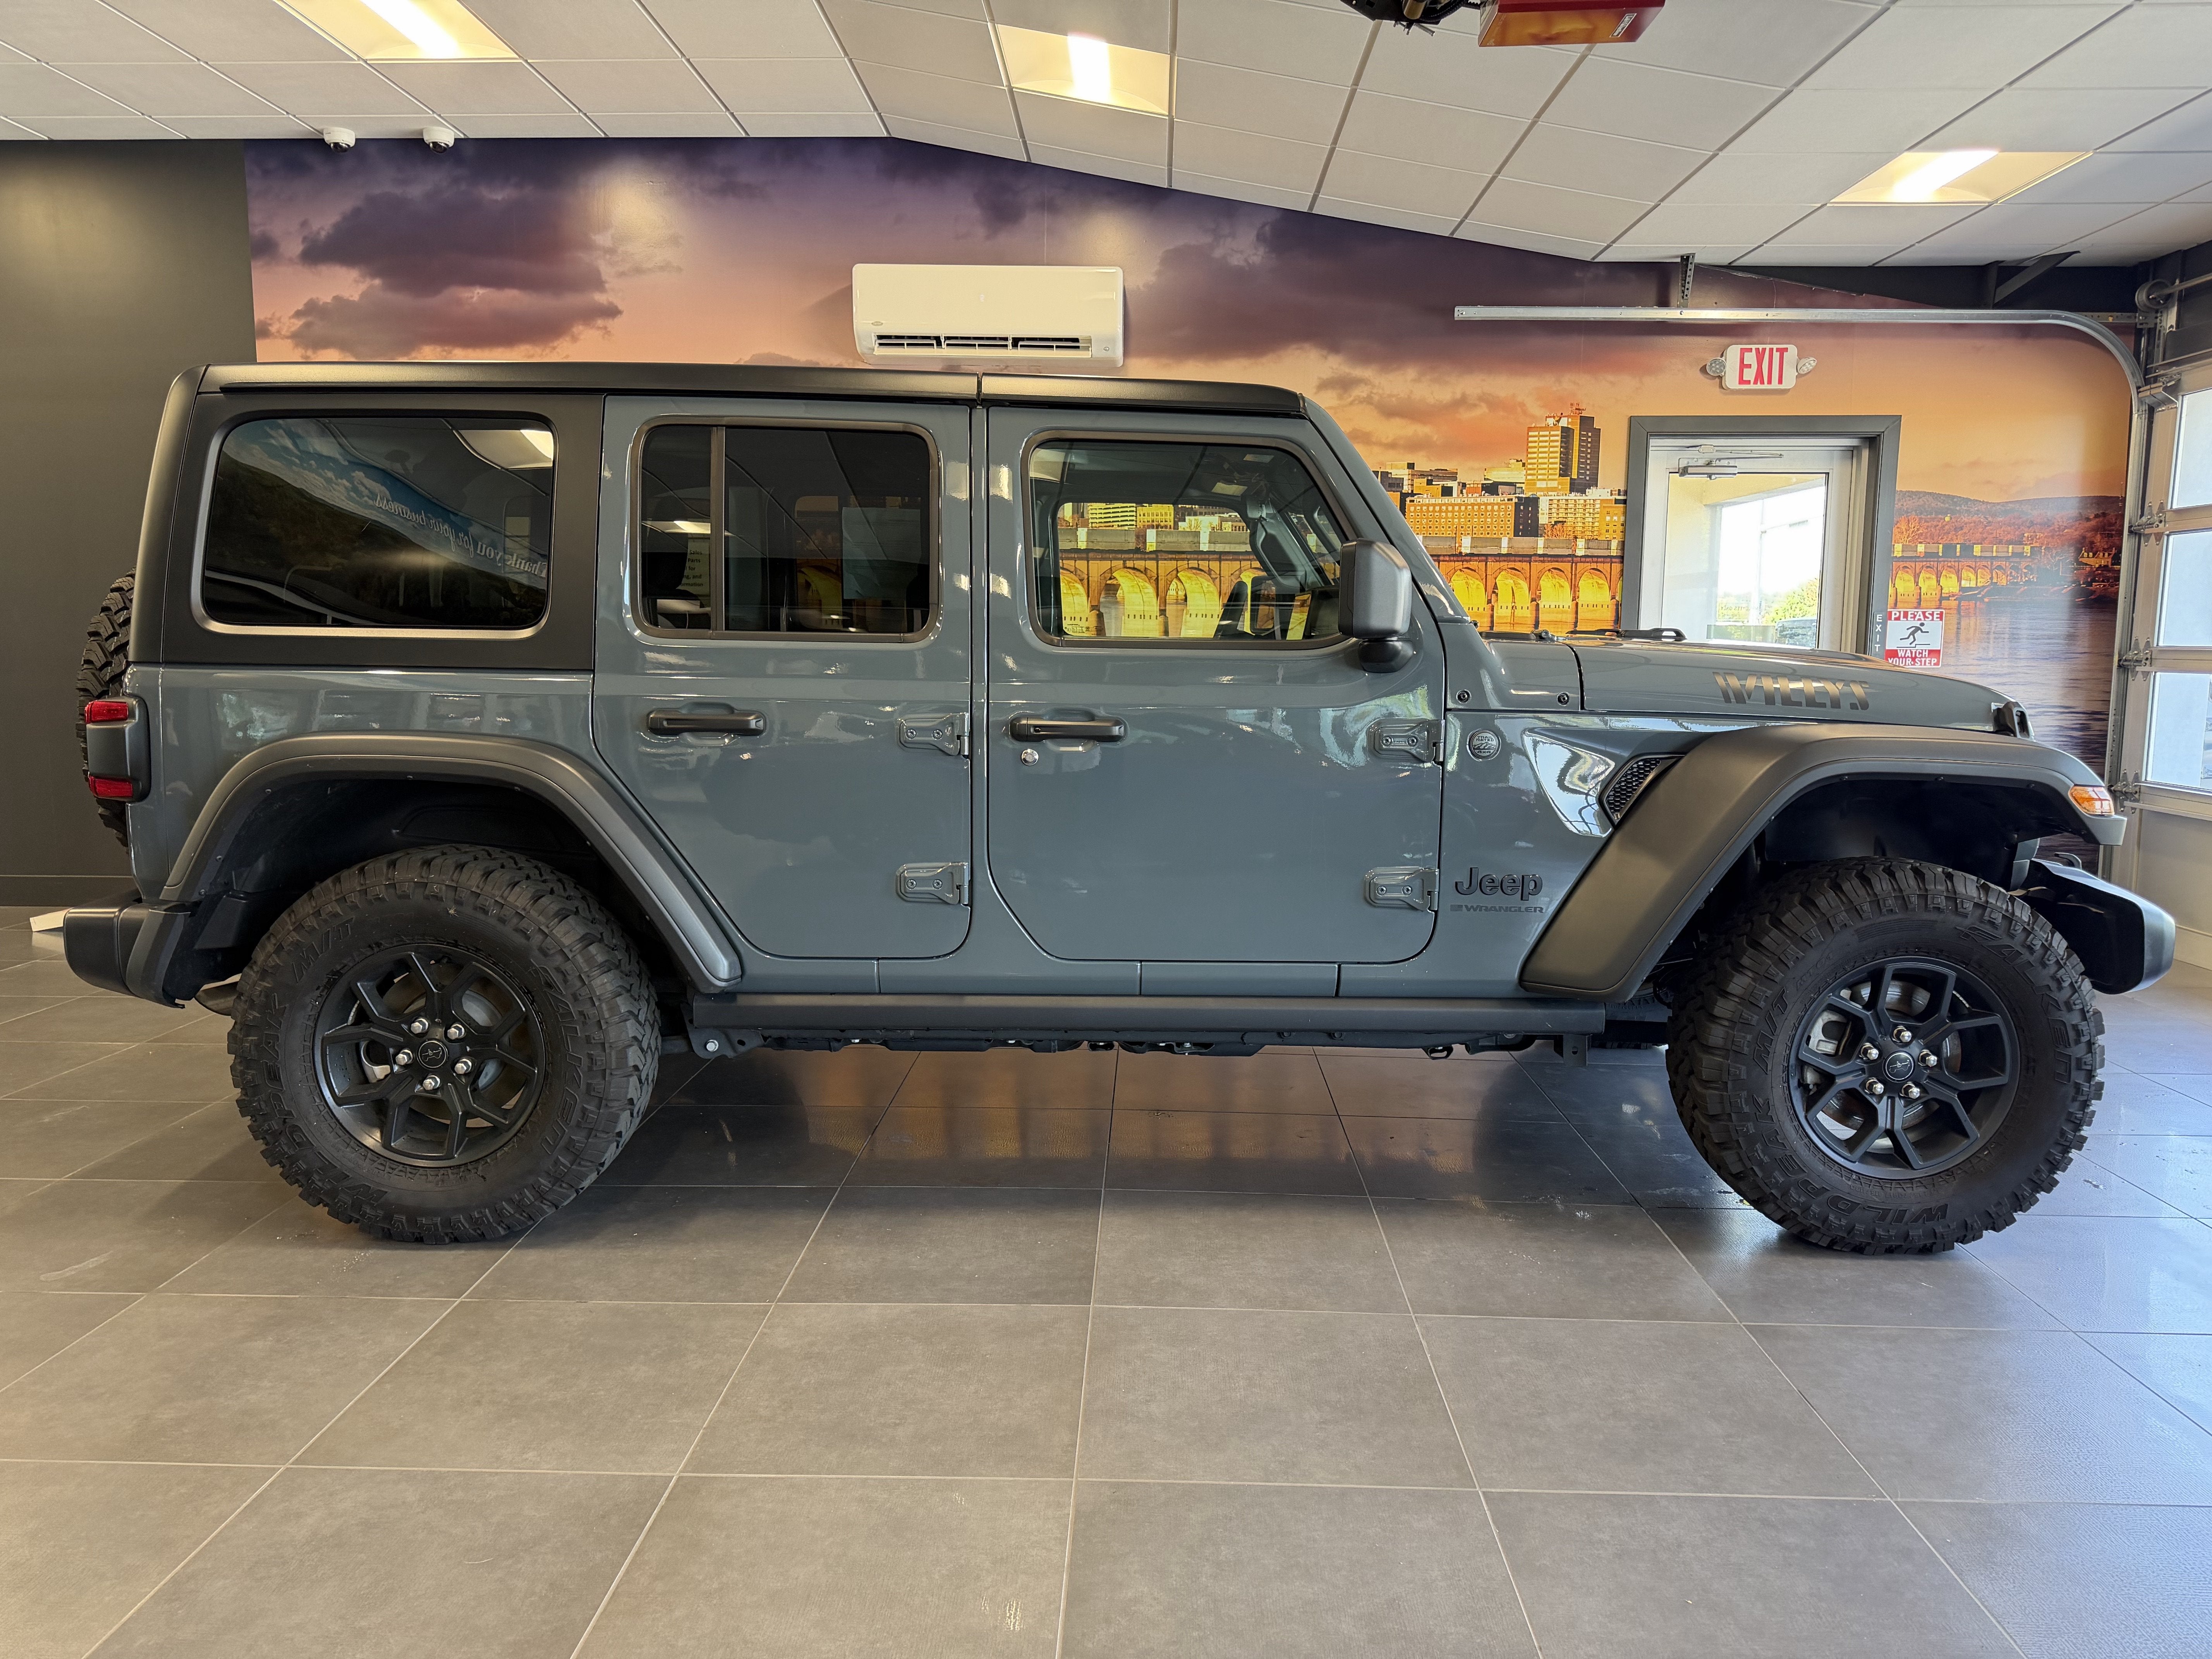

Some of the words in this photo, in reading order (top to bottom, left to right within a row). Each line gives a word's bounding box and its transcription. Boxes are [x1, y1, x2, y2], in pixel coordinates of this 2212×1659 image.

[1738, 347, 1789, 385] EXIT
[1874, 614, 1883, 652] EXIT
[1891, 611, 1941, 621] PLEASE
[1888, 658, 1911, 666] YOUR
[1915, 658, 1937, 666] STEP
[1898, 649, 1929, 658] WATCH
[1712, 672, 1870, 711] WILLYS
[1455, 867, 1543, 901] Jeep
[1464, 904, 1544, 913] WRANGLER
[1752, 1094, 1949, 1225] WILDPEAK
